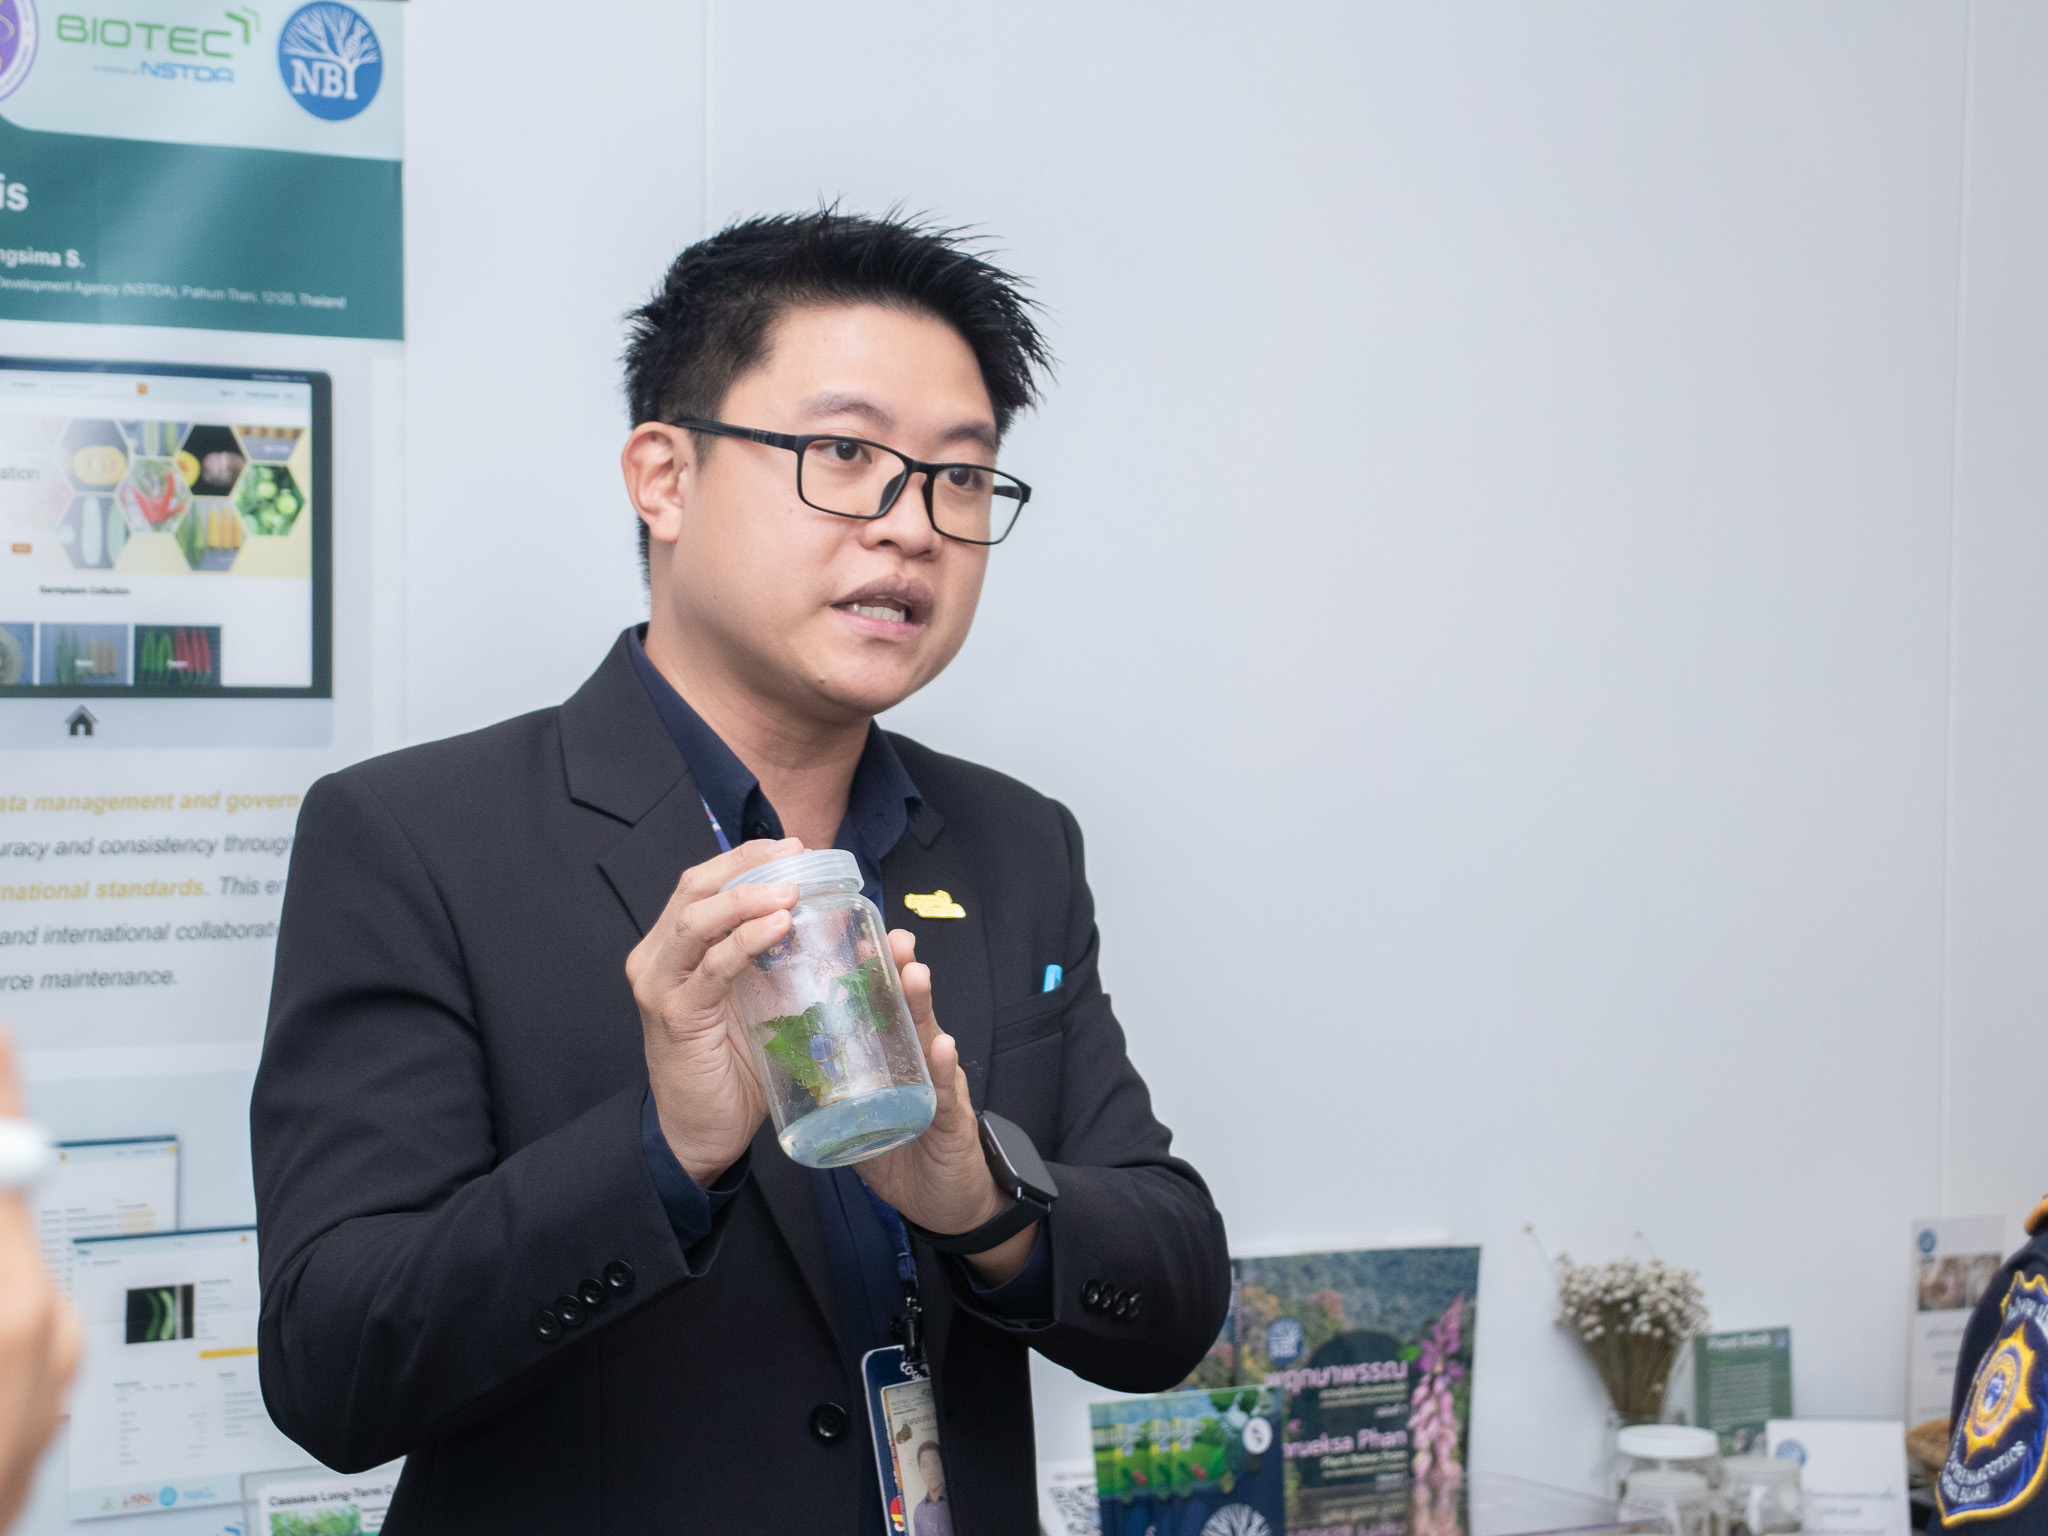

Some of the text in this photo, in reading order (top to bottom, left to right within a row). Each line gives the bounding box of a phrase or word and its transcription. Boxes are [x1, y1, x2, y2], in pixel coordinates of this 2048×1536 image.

[57, 14, 233, 58] BIOTEC
[140, 60, 235, 83] NSTDA
[290, 58, 359, 100] NBI
[65, 248, 86, 268] S.
[1, 466, 40, 482] ation
[33, 793, 174, 815] management
[179, 791, 220, 809] and
[53, 836, 94, 856] and
[99, 835, 217, 858] consistency
[0, 880, 90, 901] national
[219, 875, 259, 896] This
[0, 925, 39, 946] and
[42, 921, 171, 944] international
[39, 967, 178, 990] maintenance.
